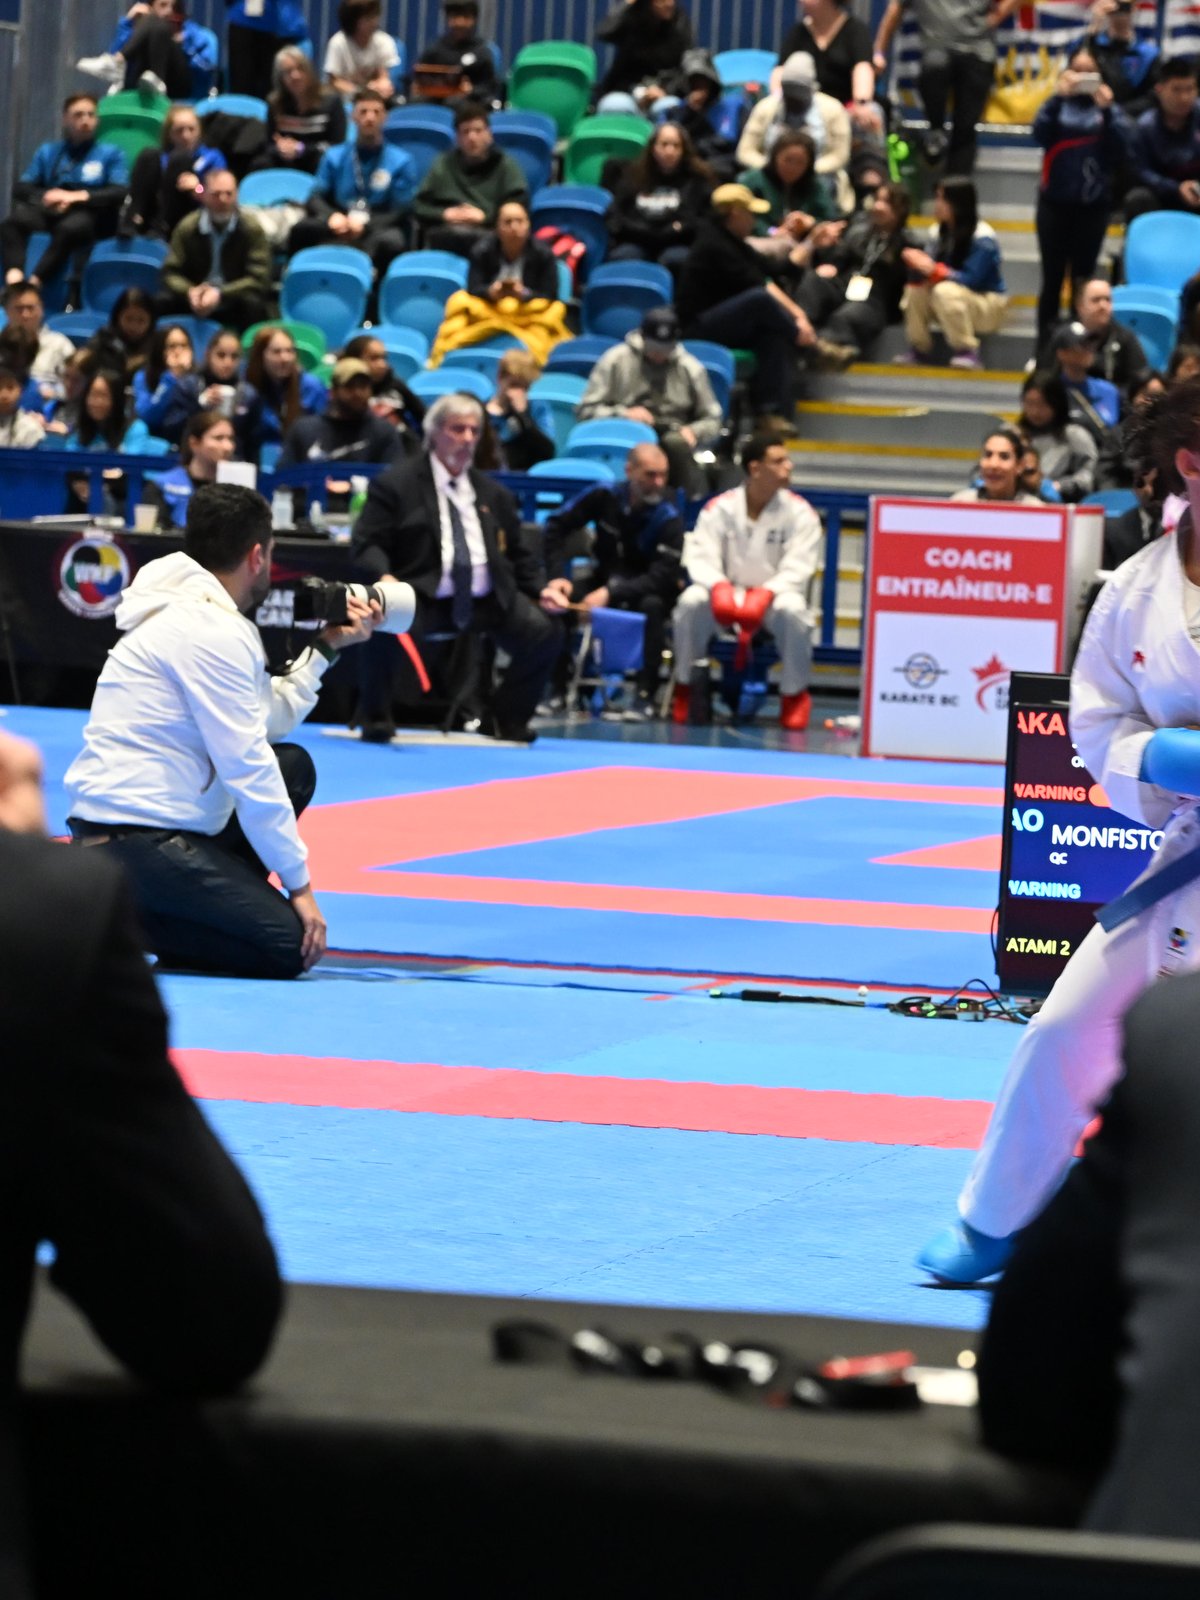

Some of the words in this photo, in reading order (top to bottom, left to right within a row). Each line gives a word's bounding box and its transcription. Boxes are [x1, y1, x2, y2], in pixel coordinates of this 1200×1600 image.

[924, 547, 1012, 571] COACH
[880, 692, 935, 705] KARATE
[940, 694, 959, 707] BC
[1049, 852, 1068, 865] QC
[1005, 937, 1057, 956] ATAMI
[1060, 940, 1071, 956] 2
